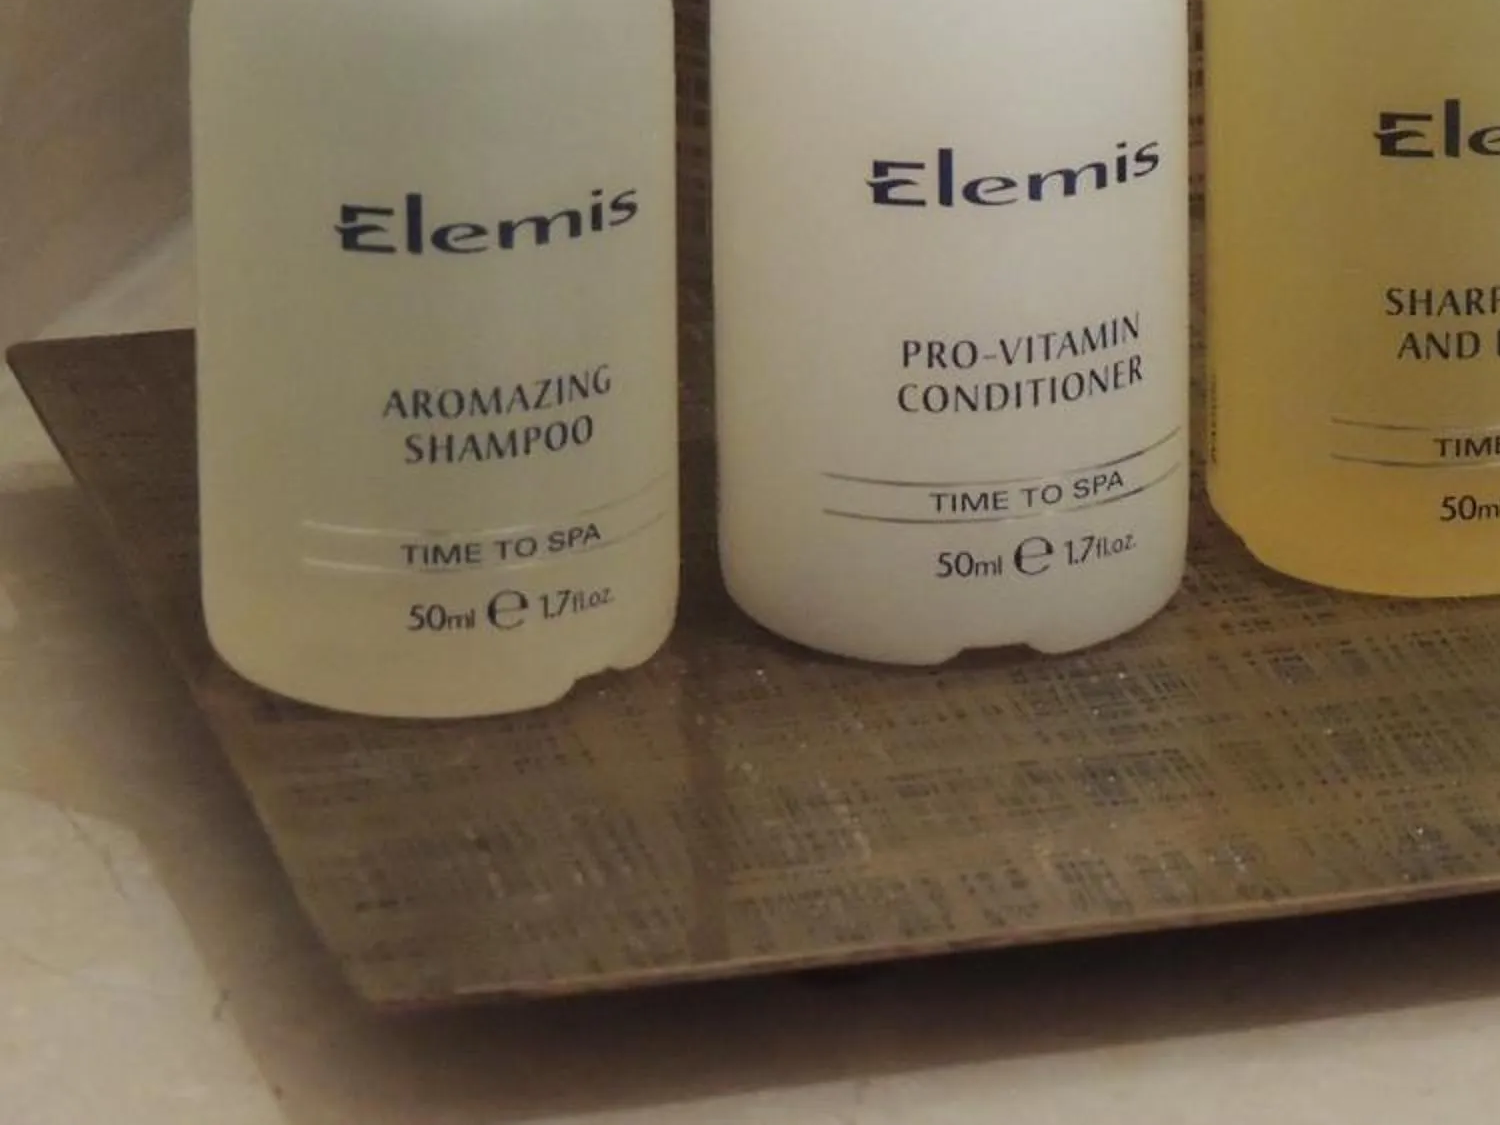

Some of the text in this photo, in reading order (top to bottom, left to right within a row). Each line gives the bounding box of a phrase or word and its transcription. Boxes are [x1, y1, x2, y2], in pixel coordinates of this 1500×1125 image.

[865, 140, 1160, 208] Elemis
[334, 188, 638, 255] Elemis
[902, 310, 1141, 370] PRO-VITAMIN
[1396, 330, 1481, 360] AND
[381, 364, 612, 419] AROMAZING
[897, 354, 1144, 413] CONDITIONER
[404, 414, 594, 464] SHAMPOO
[929, 470, 1125, 514] TIME TO SPA
[400, 523, 602, 565] TIME TO SPA
[936, 551, 1003, 579] 50ml
[407, 603, 475, 632] 50ml
